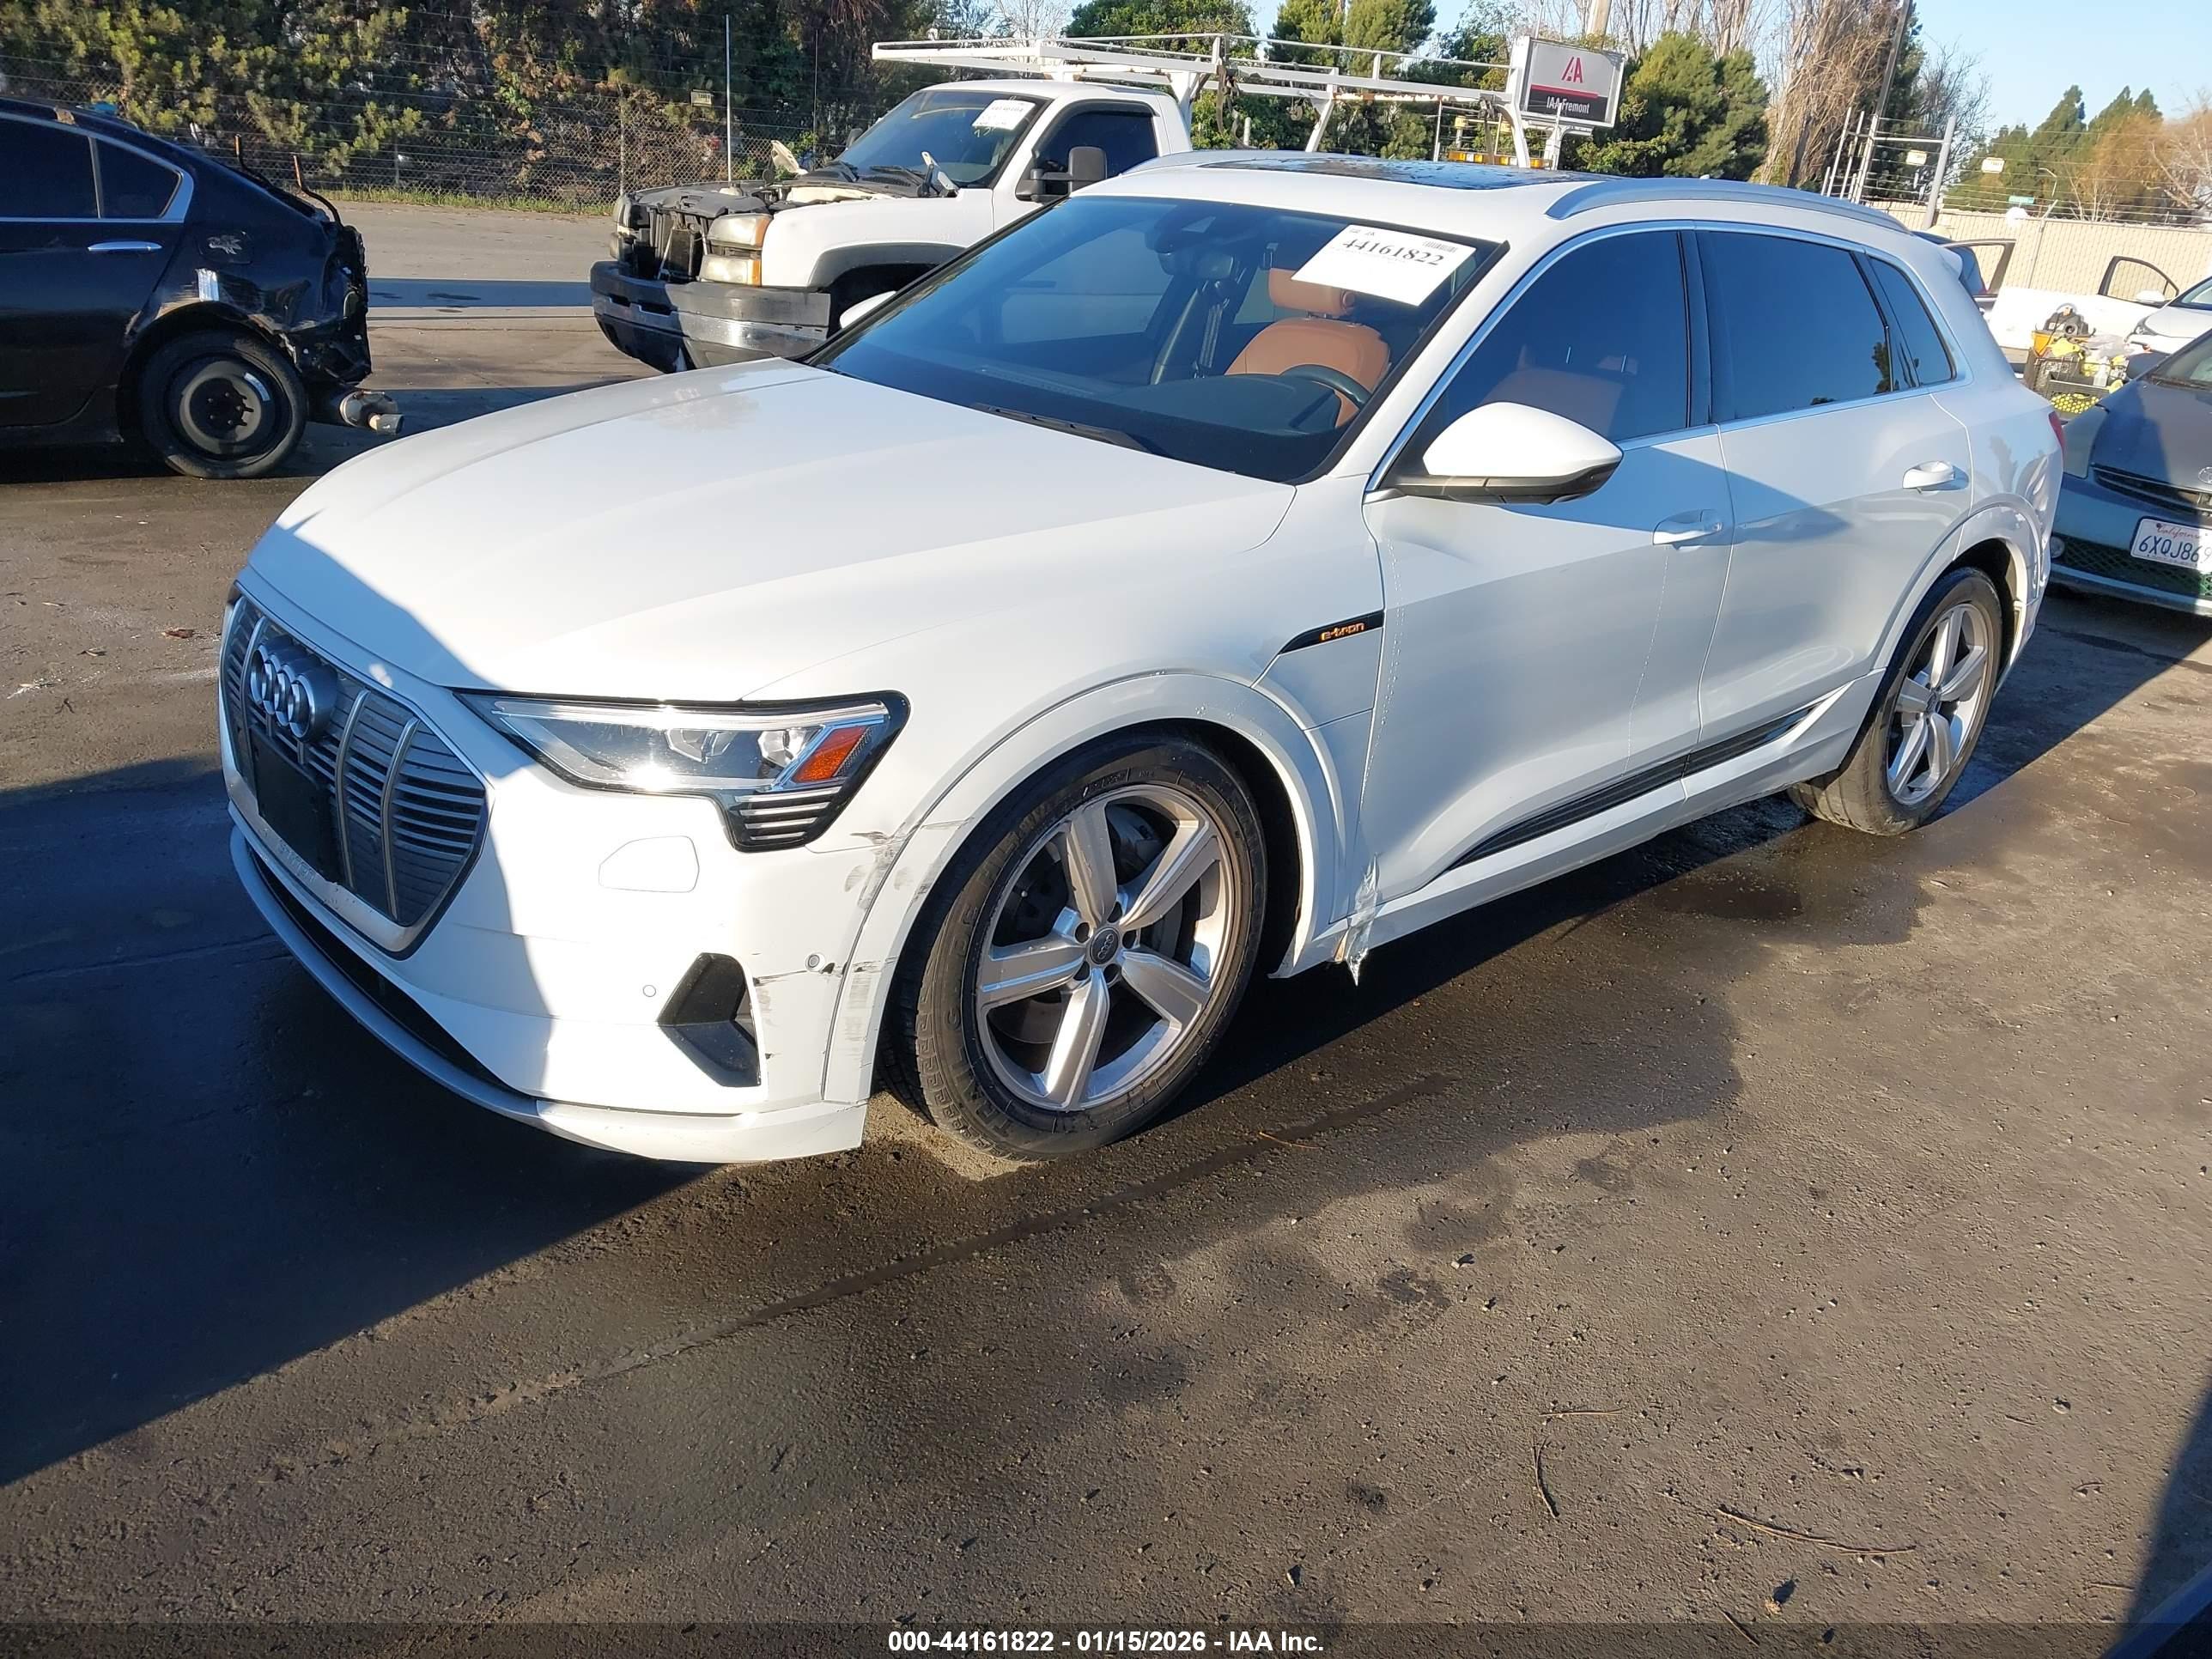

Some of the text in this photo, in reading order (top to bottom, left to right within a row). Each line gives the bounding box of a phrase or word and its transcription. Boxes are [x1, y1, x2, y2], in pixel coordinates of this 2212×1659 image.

[1546, 95, 1590, 114] IAA Fremont
[1342, 238, 1445, 266] 44161822
[2138, 535, 2212, 563] 6XQJ869
[1321, 622, 1365, 641] e-tron
